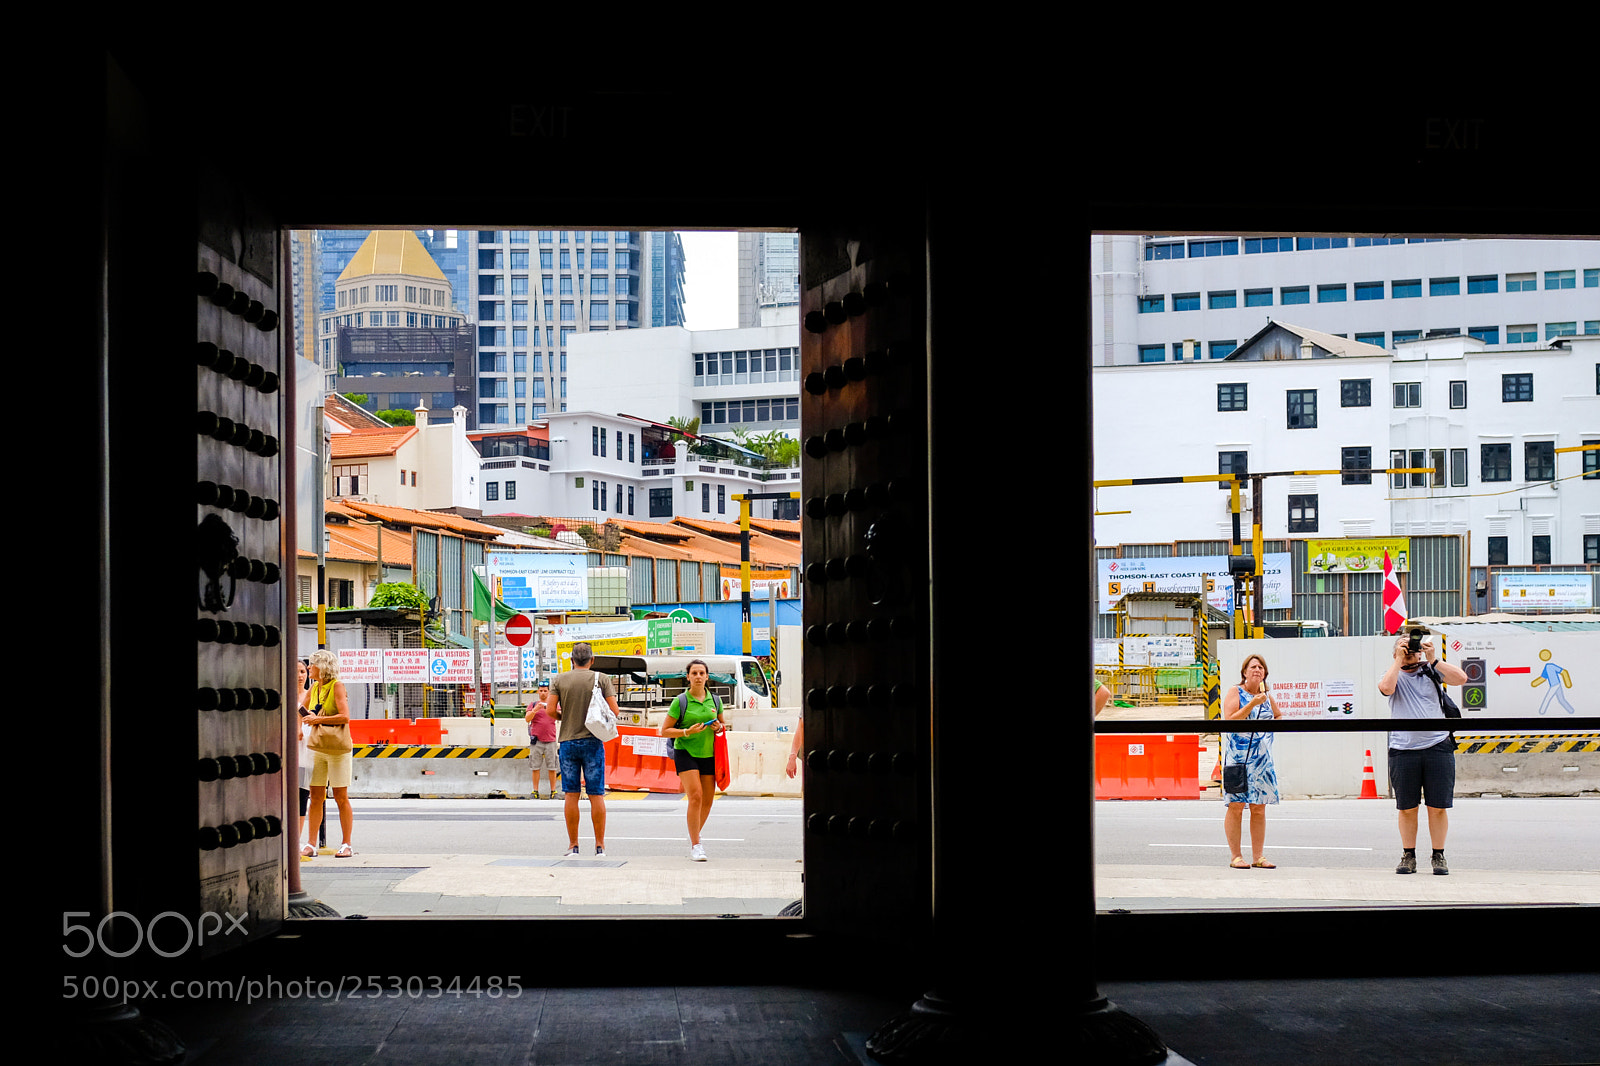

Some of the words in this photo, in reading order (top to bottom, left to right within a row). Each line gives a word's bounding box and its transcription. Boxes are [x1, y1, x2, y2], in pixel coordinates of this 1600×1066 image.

[510, 104, 575, 138] EXIT
[1425, 118, 1485, 149] EXIT
[451, 659, 469, 667] MUST
[1273, 682, 1308, 690] DANGER-KEEP
